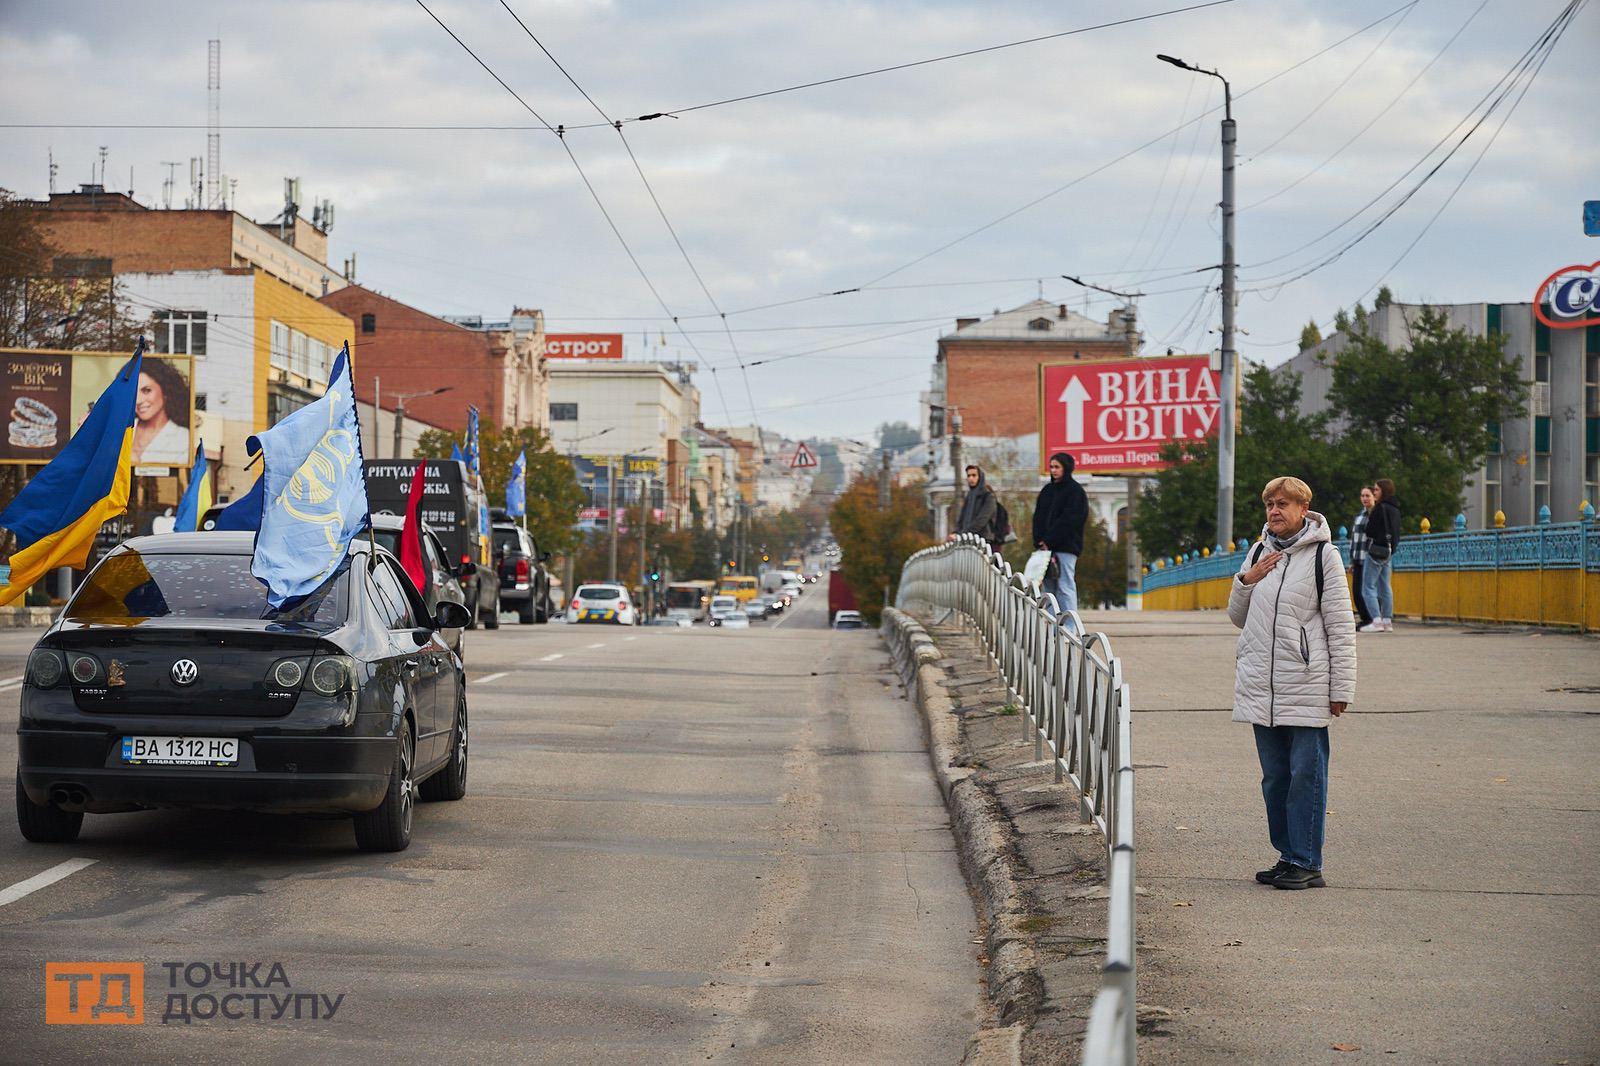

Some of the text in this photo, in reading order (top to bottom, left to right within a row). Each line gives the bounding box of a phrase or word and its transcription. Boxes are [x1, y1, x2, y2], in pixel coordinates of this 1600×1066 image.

[1097, 367, 1220, 406] ВИНА
[1097, 403, 1221, 443] СВІТУ
[1081, 452, 1124, 465] Велика
[166, 741, 205, 757] 1312
